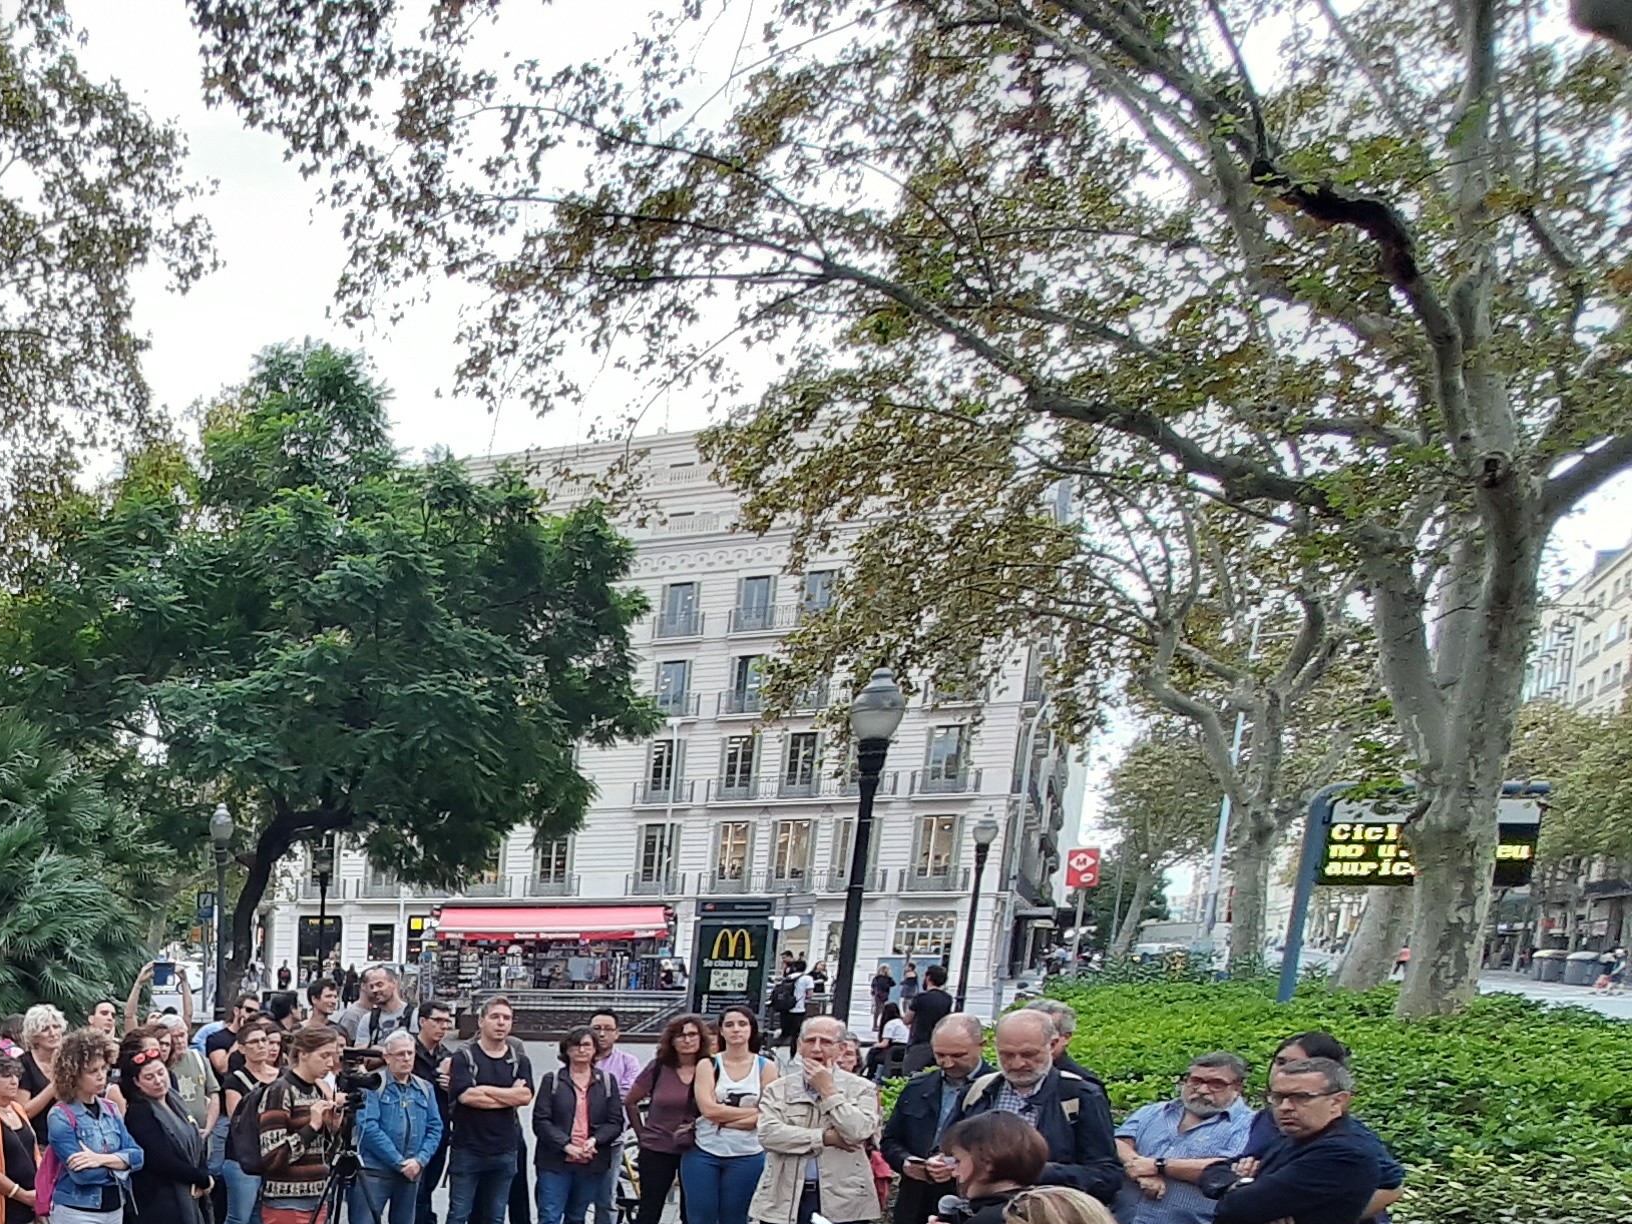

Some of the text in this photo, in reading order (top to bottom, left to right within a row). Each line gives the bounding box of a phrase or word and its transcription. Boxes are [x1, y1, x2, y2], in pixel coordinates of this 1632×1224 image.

[1329, 844, 1365, 858] no
[1325, 858, 1416, 876] auric
[702, 958, 759, 969] So close to you
